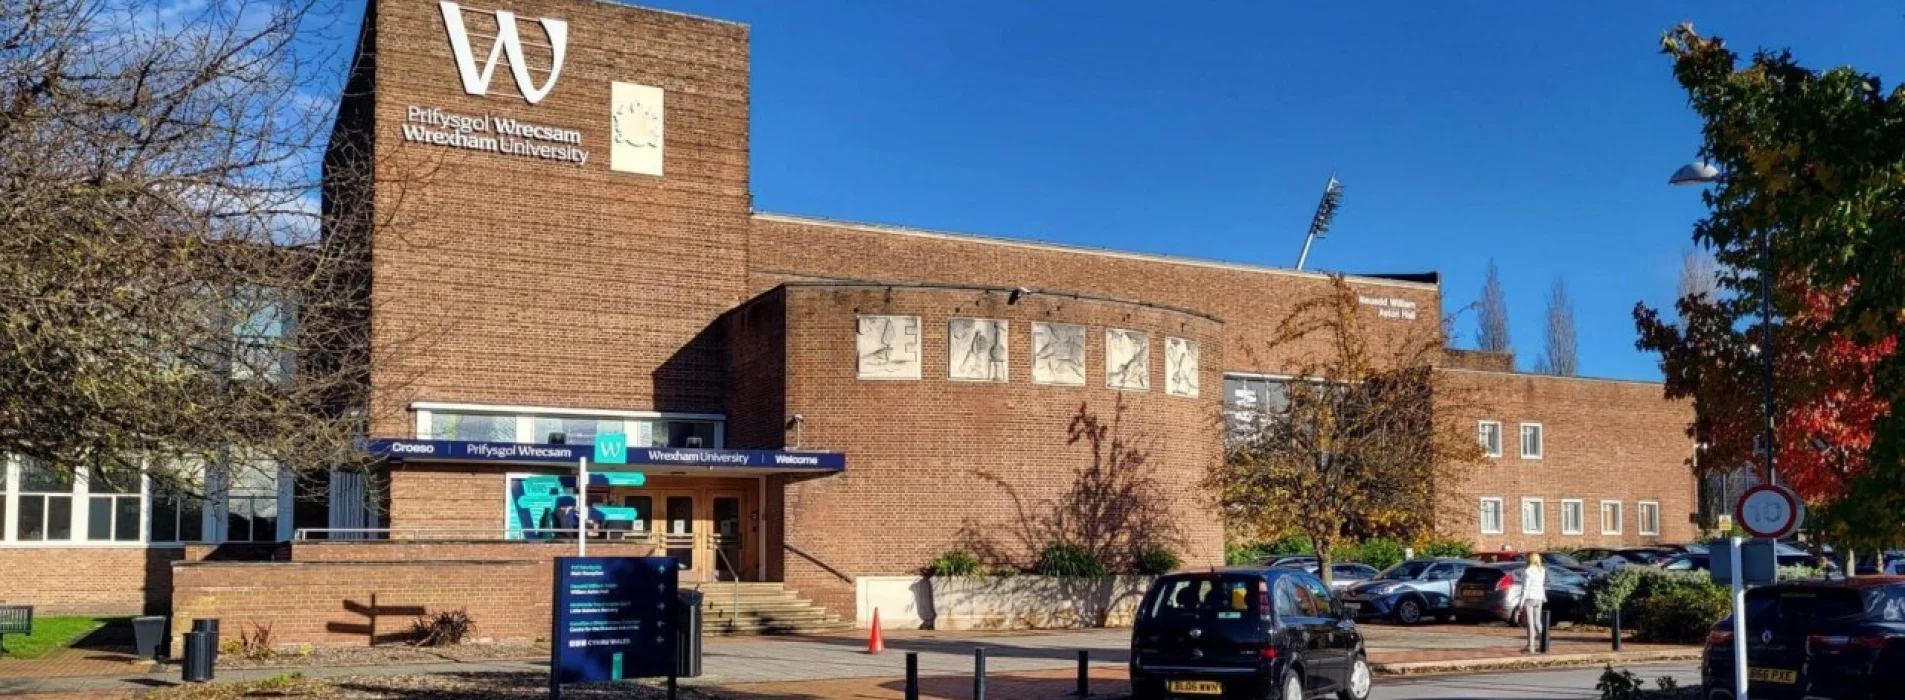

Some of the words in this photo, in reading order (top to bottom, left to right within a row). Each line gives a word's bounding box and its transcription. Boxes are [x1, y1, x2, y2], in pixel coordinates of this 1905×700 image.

[439, 1, 568, 104] W
[408, 105, 490, 133] Prifysgol
[494, 117, 582, 144] Wrecsam
[402, 124, 498, 151] Wrexham
[499, 137, 590, 165] University
[392, 442, 434, 454] Croeso
[466, 443, 516, 458] Prifysgol
[518, 444, 572, 458] Wrecsam
[600, 441, 621, 457] W
[648, 450, 699, 462] Wrexham
[699, 450, 749, 465] University
[774, 454, 818, 465] Welcome
[1749, 501, 1783, 523] 10
